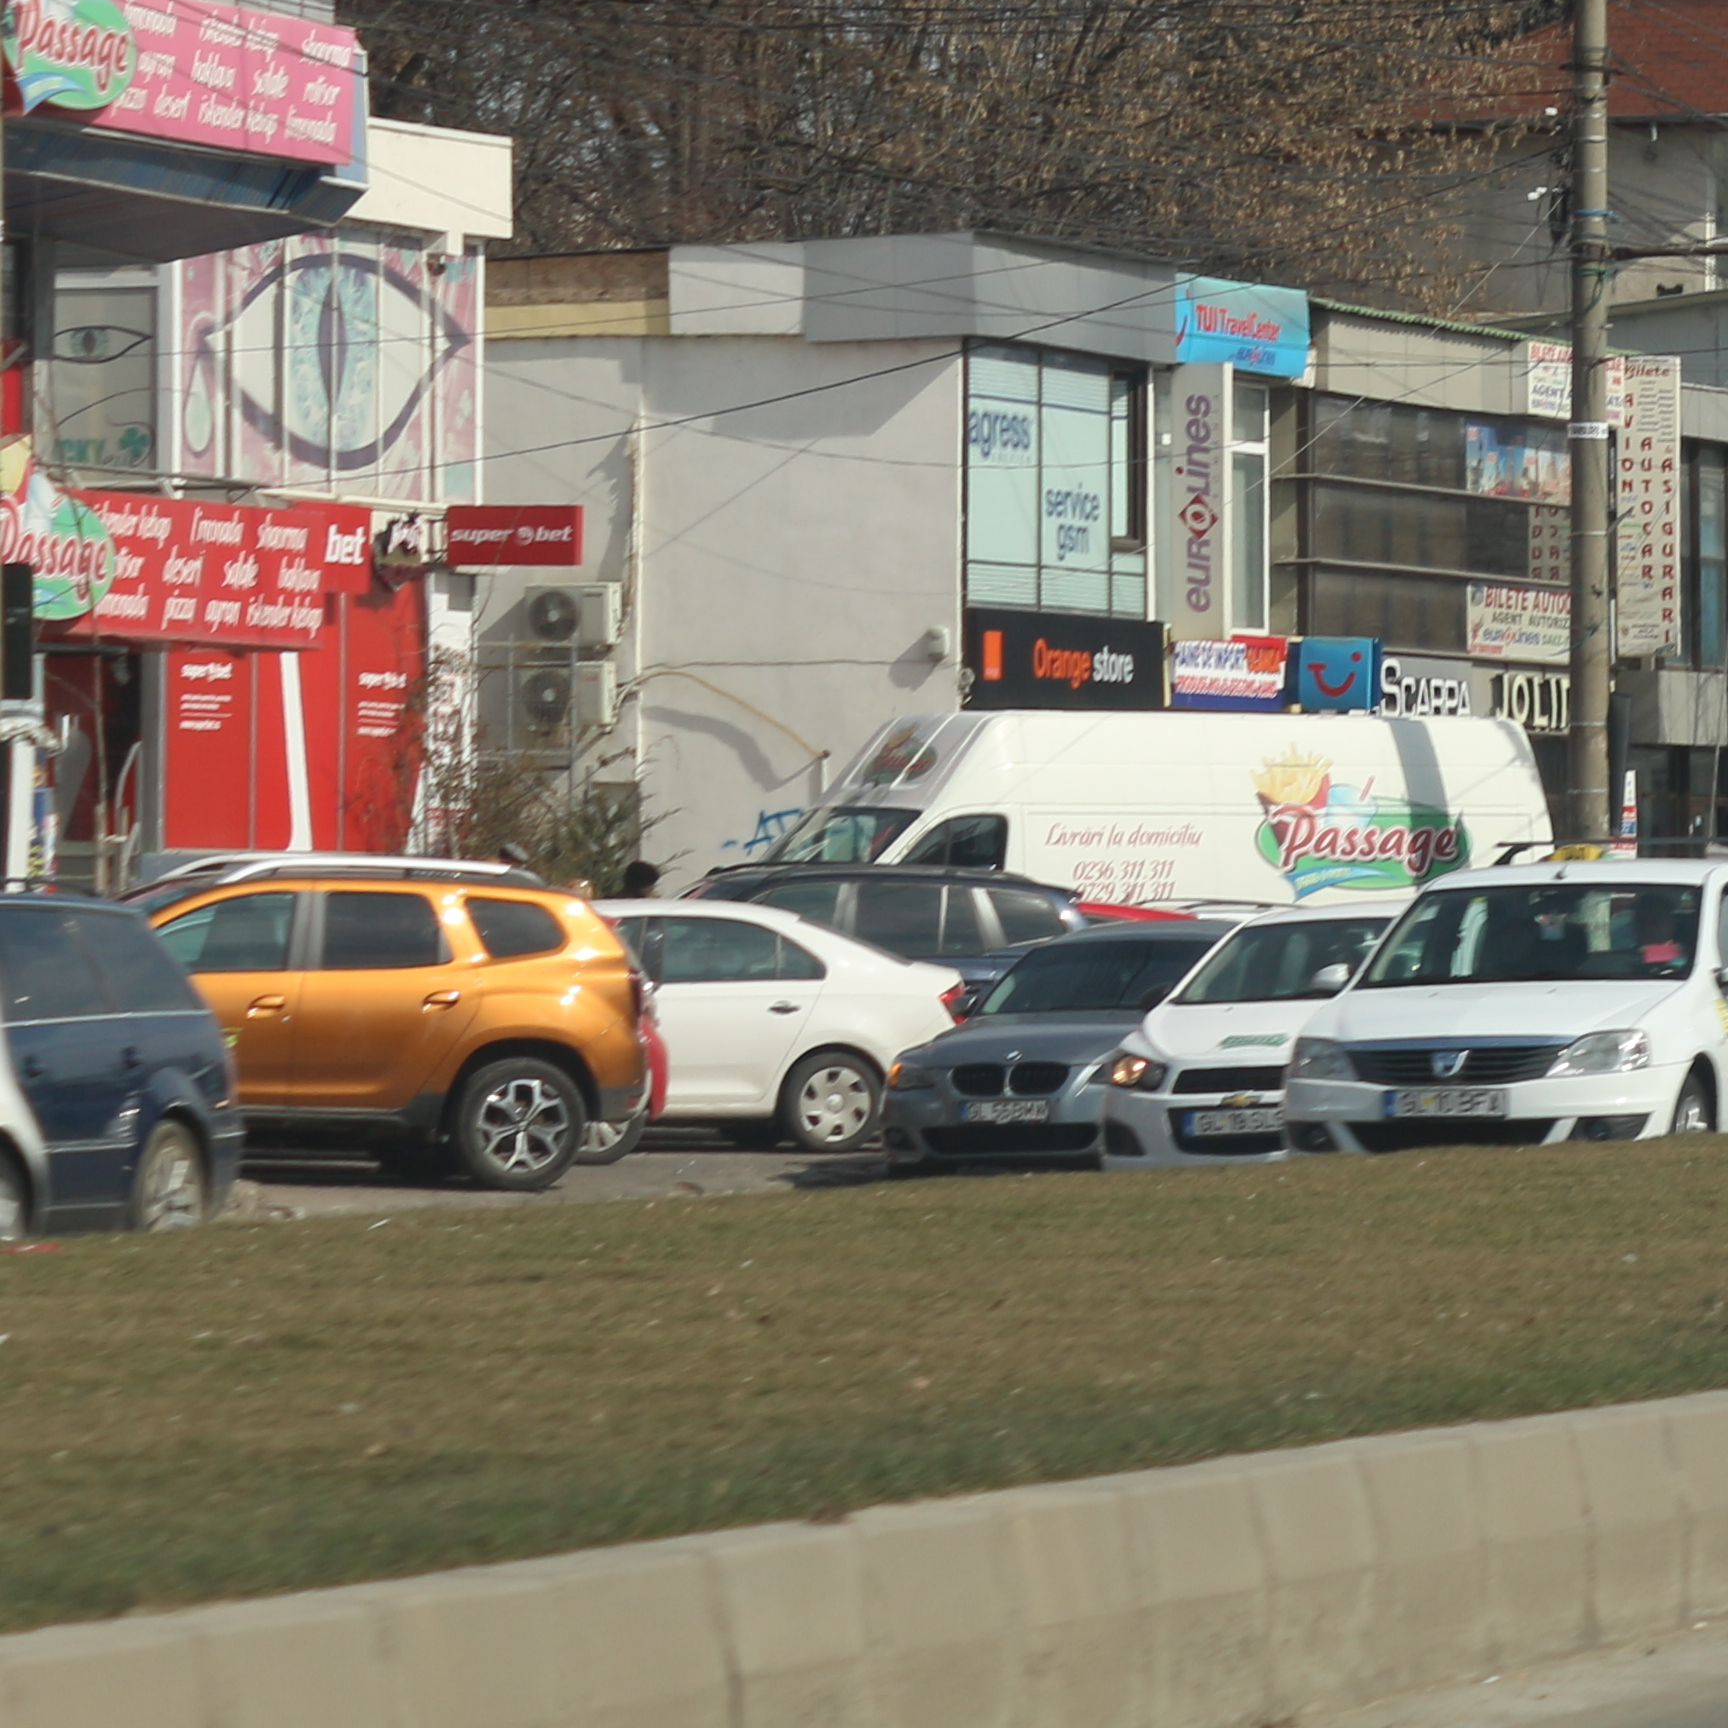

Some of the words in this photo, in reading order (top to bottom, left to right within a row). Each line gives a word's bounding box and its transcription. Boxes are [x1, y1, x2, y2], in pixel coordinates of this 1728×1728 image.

[1195, 304, 1218, 333] TUI
[1624, 364, 1671, 380] Bilete
[969, 410, 1031, 458] agress
[1621, 393, 1634, 493] AVION
[1045, 482, 1100, 522] service
[1641, 437, 1654, 580] AUTOCAR
[324, 523, 367, 566] bet
[1058, 524, 1090, 562] gsm
[1661, 457, 1674, 643] ASIGURARI
[1485, 584, 1531, 612] BILETE
[1033, 638, 1092, 690] Orange
[1093, 644, 1135, 685] store
[1107, 822, 1124, 849] la
[1128, 823, 1204, 849] domiciliu
[1273, 806, 1459, 877] Passage
[1072, 858, 1174, 883] 0236.311.311
